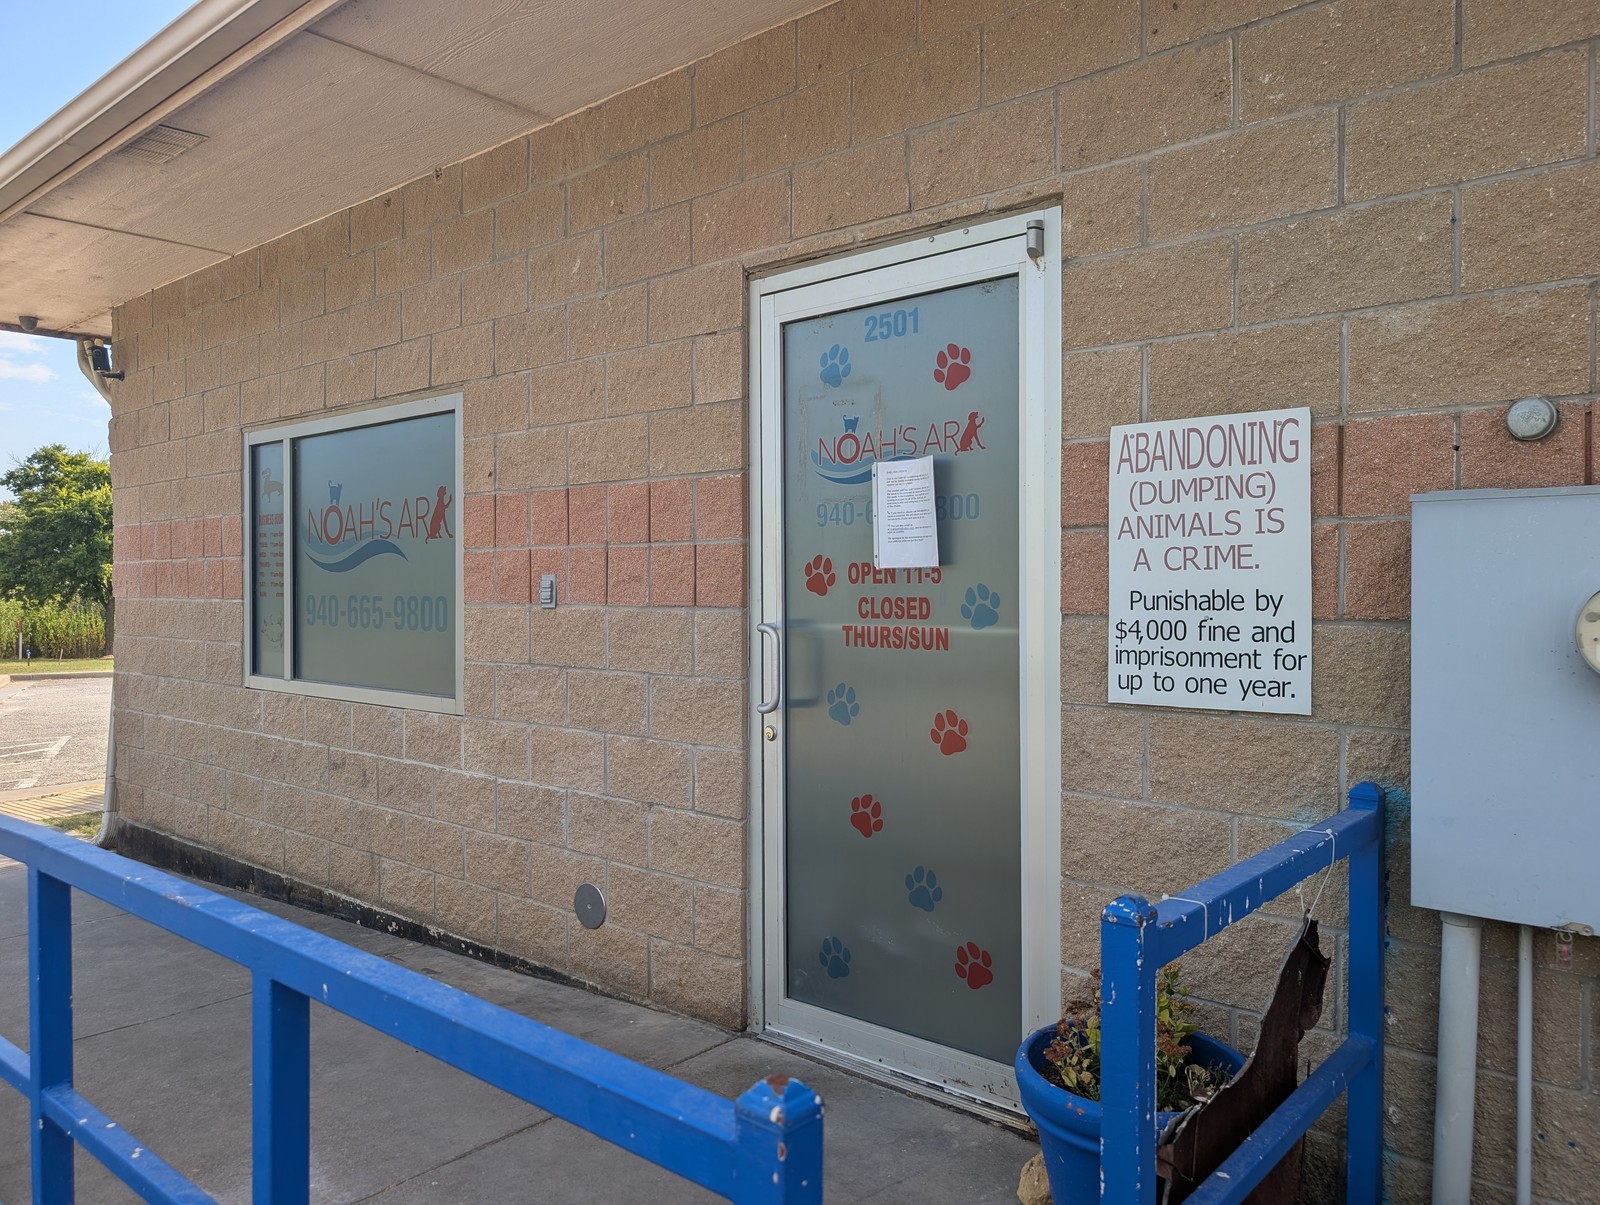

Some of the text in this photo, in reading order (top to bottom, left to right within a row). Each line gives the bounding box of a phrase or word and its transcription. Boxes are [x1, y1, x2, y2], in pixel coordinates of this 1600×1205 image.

[864, 307, 919, 342] 2501
[819, 425, 917, 465] NOAH'S
[1116, 418, 1299, 474] ABANDONING
[1129, 471, 1276, 512] (DUMPING)
[308, 498, 392, 545] NOAH'S
[1117, 507, 1285, 540] ANIMALS IS
[1133, 544, 1260, 571] A CRIME.
[847, 562, 942, 584] OPEN 11-5
[306, 594, 448, 632] 940-665-9800
[858, 596, 931, 619] CLOSED
[1130, 589, 1284, 617] Punishable by
[842, 625, 949, 651] THURS/SUN
[1115, 617, 1295, 645] $4,000 fine and
[1115, 645, 1307, 671] imprisonment for
[1118, 671, 1296, 701] up to one year.
